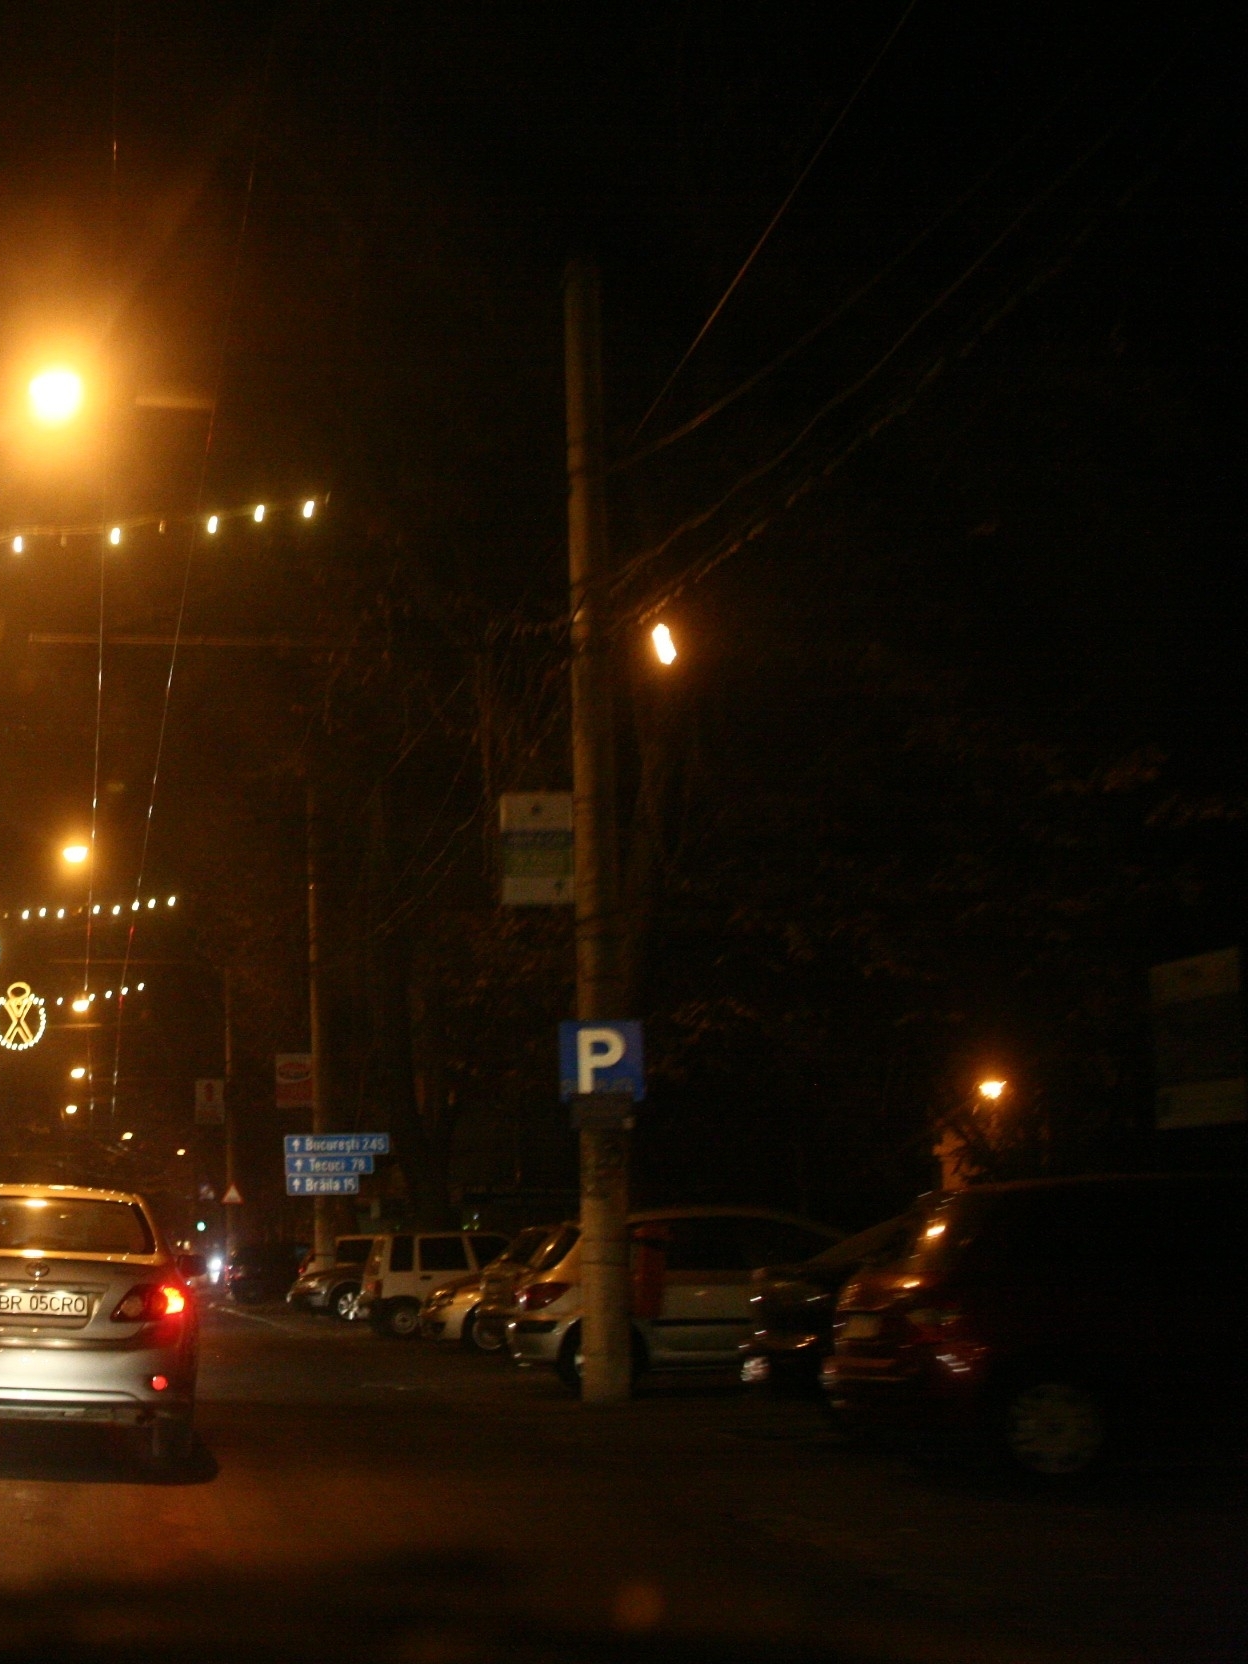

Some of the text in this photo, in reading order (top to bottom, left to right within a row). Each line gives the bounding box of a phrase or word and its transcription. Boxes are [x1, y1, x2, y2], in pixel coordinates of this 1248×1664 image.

[577, 1028, 625, 1094] P
[362, 1137, 386, 1151] 245
[309, 1158, 345, 1172] Tecuci
[29, 1295, 85, 1312] 05CRO
